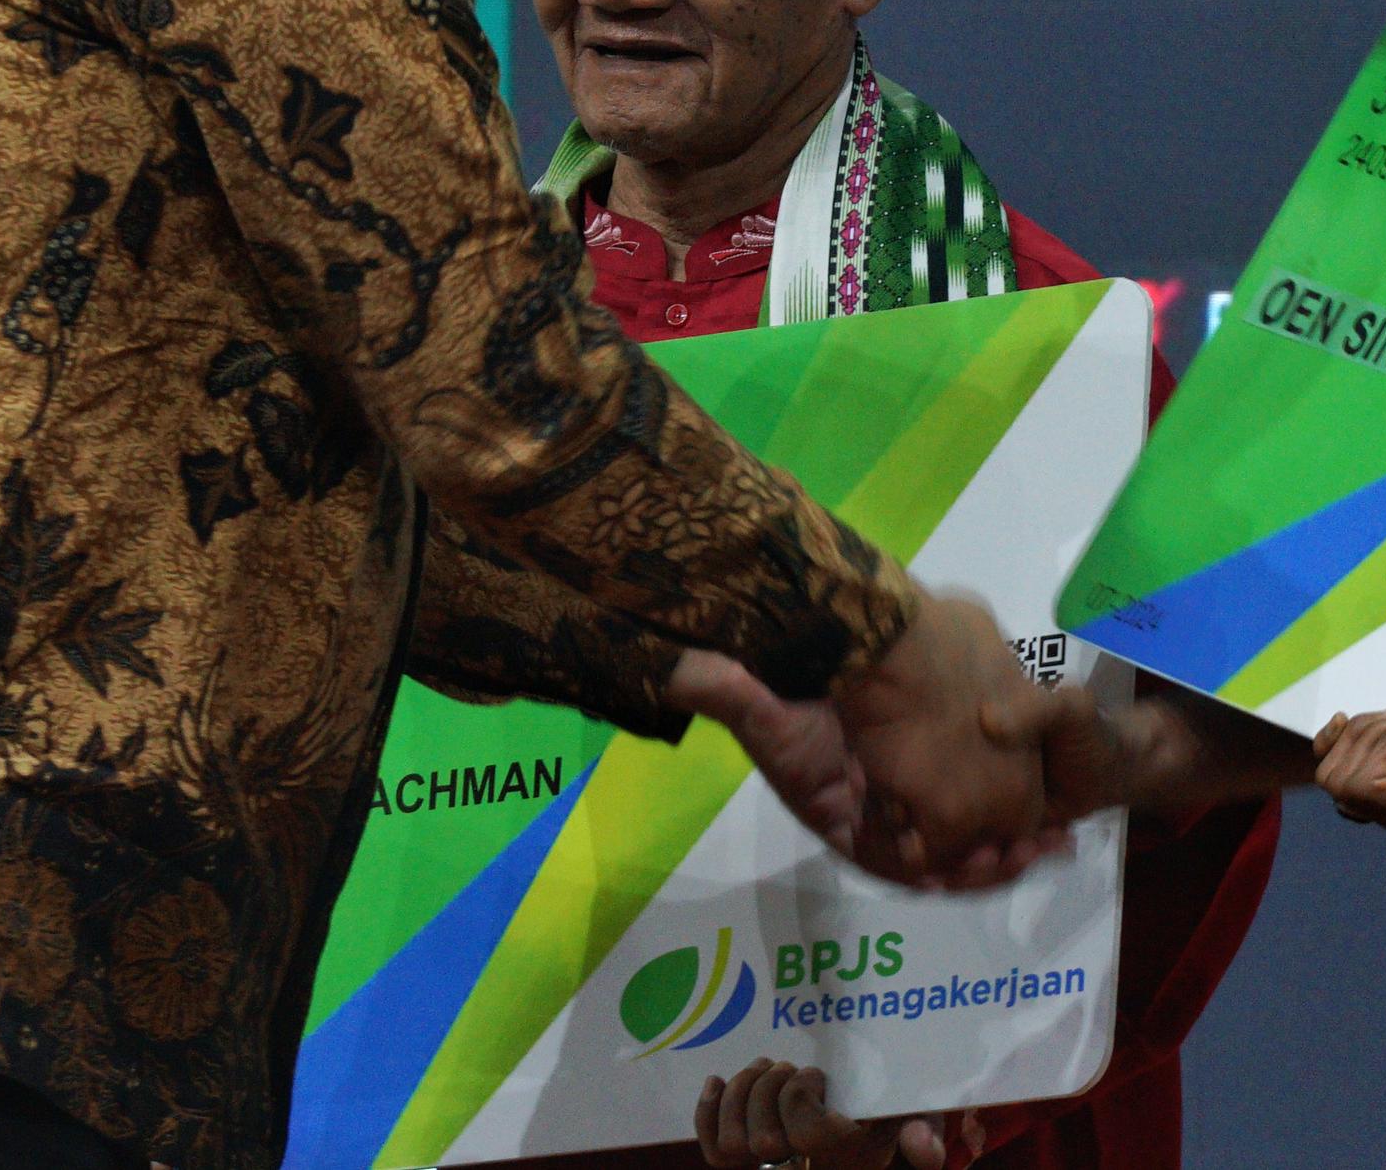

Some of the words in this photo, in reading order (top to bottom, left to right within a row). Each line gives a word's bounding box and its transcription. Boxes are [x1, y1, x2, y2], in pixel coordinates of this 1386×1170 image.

[1258, 278, 1347, 346] OEN
[774, 931, 905, 990] BPJS
[771, 966, 1086, 1030] Ketenagakerjaan
